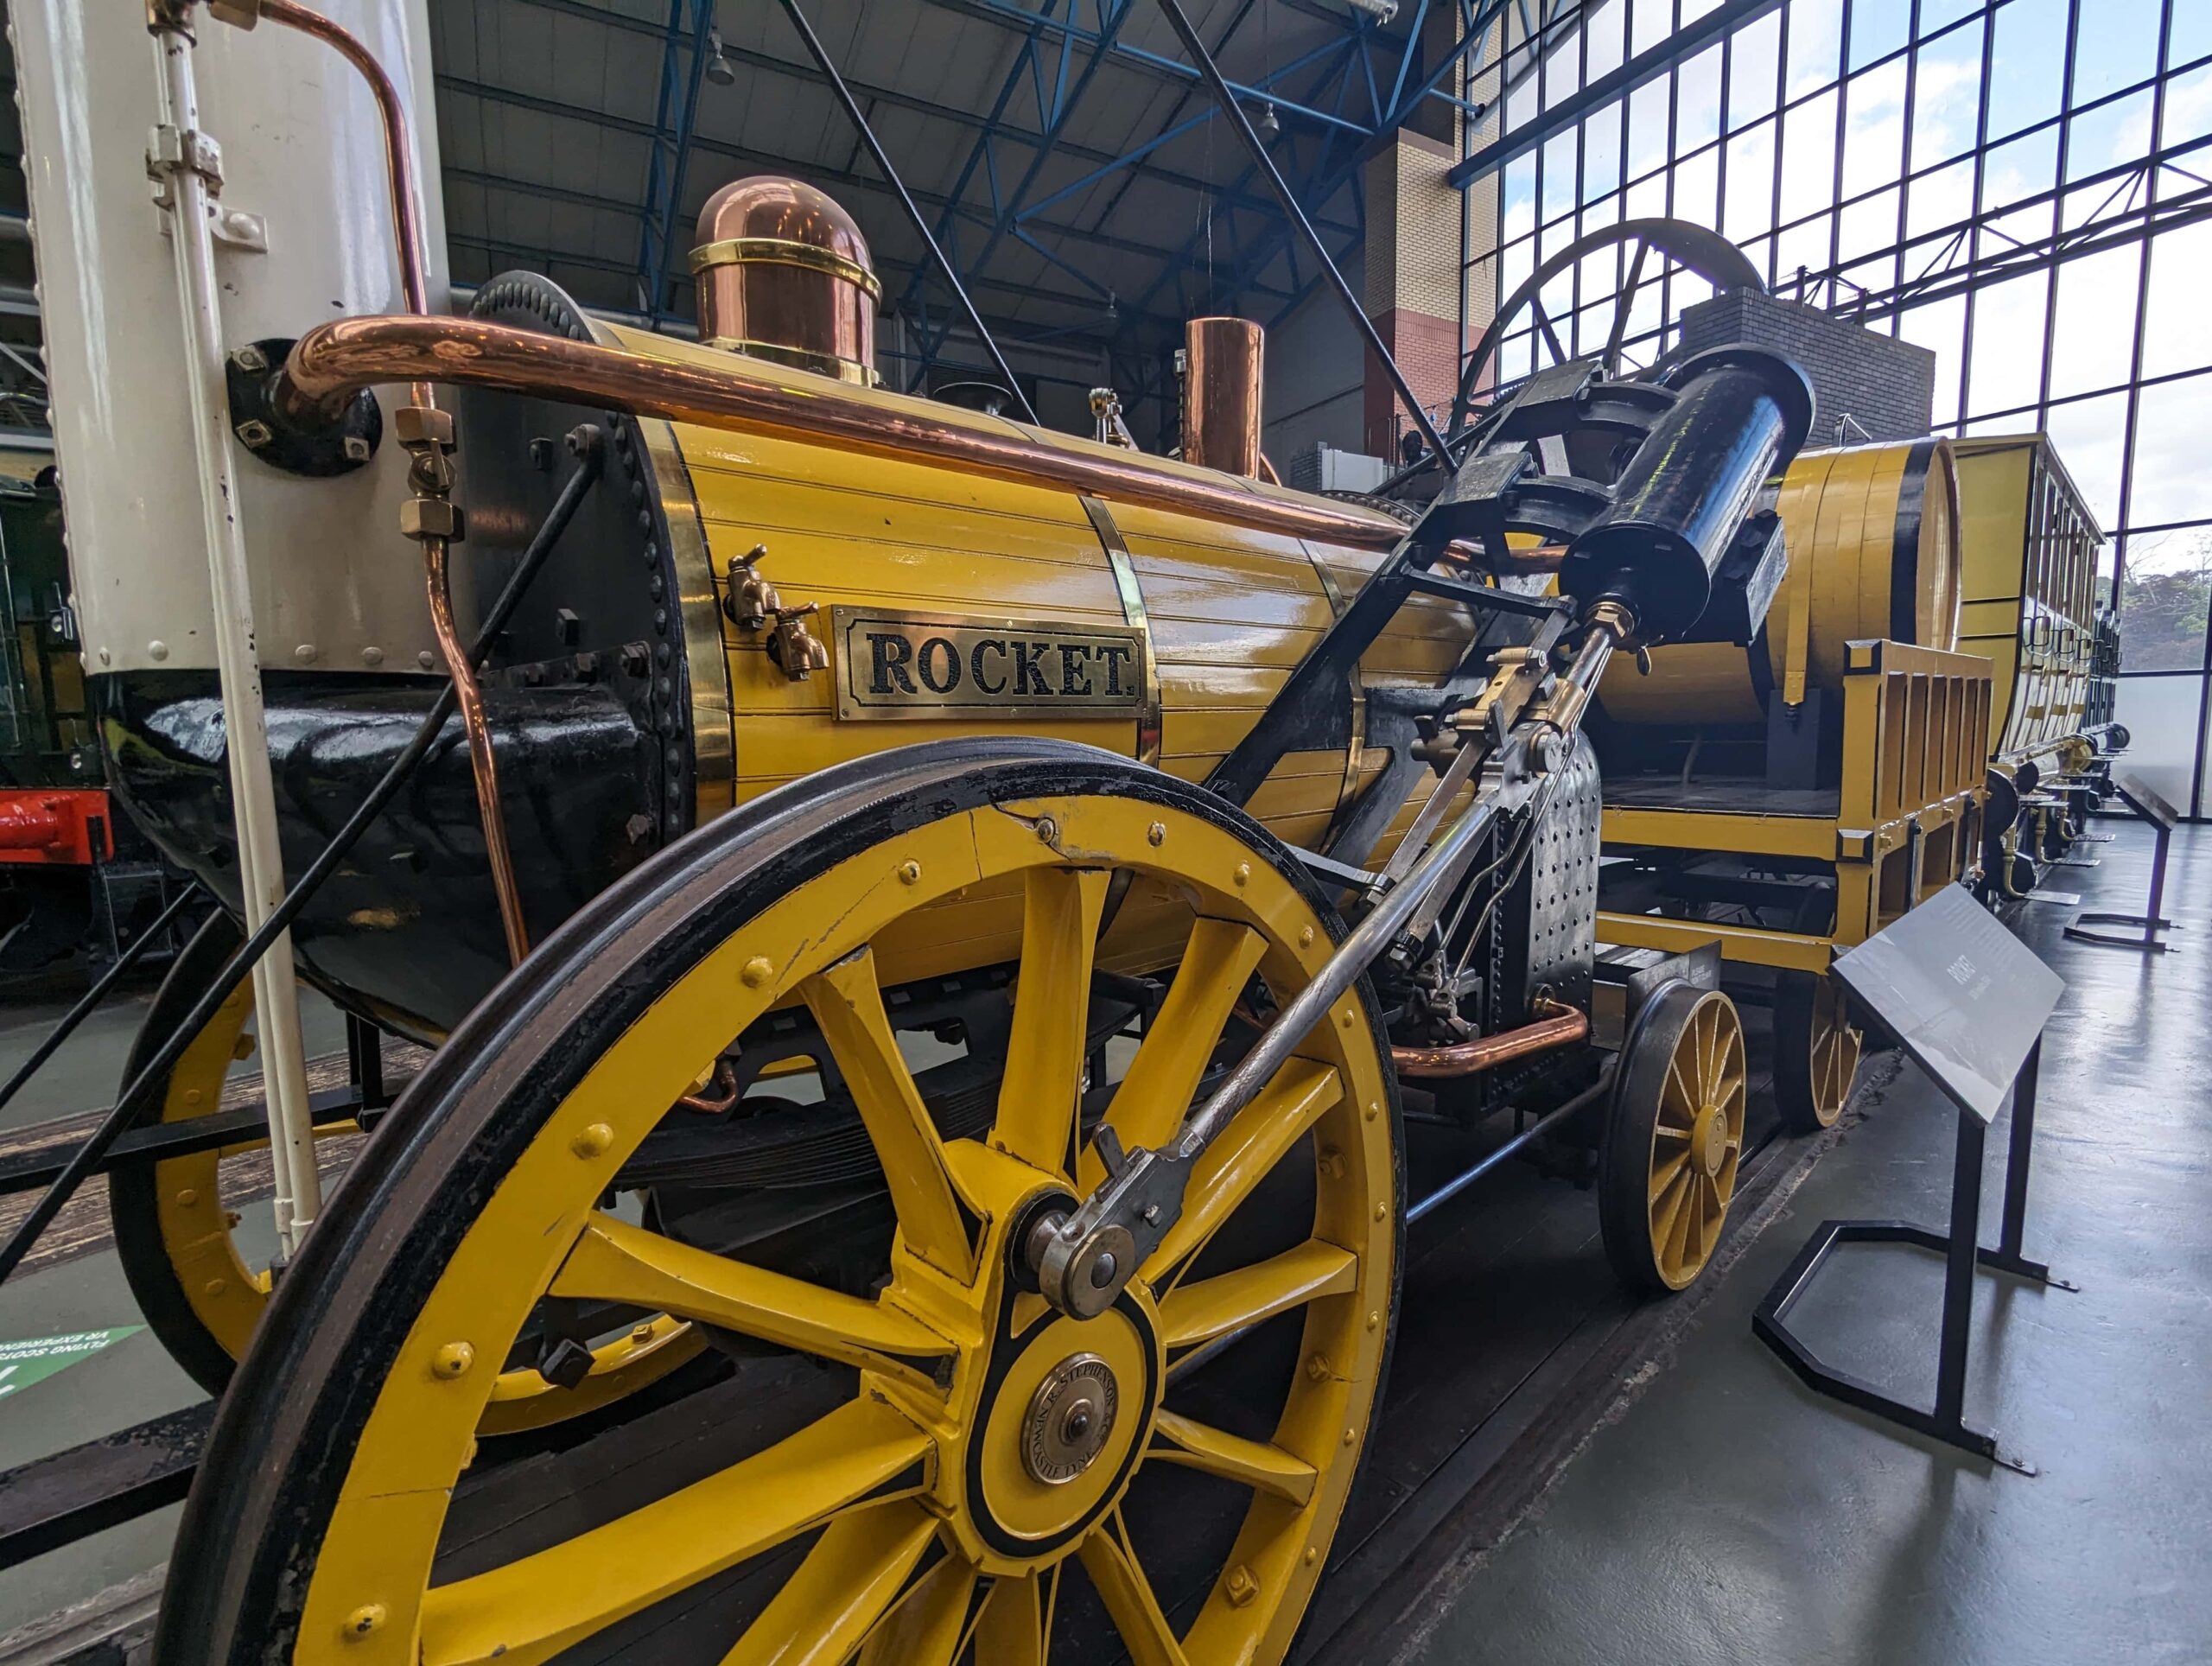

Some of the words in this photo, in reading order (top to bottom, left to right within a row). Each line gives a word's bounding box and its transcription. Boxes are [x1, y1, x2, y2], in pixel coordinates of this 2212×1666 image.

[50, 1339, 111, 1354] FLYING
[85, 1331, 110, 1340] VR
[1059, 1364, 1115, 1407] STEPHENSON
[1033, 1406, 1059, 1478] NEWCASTLE
